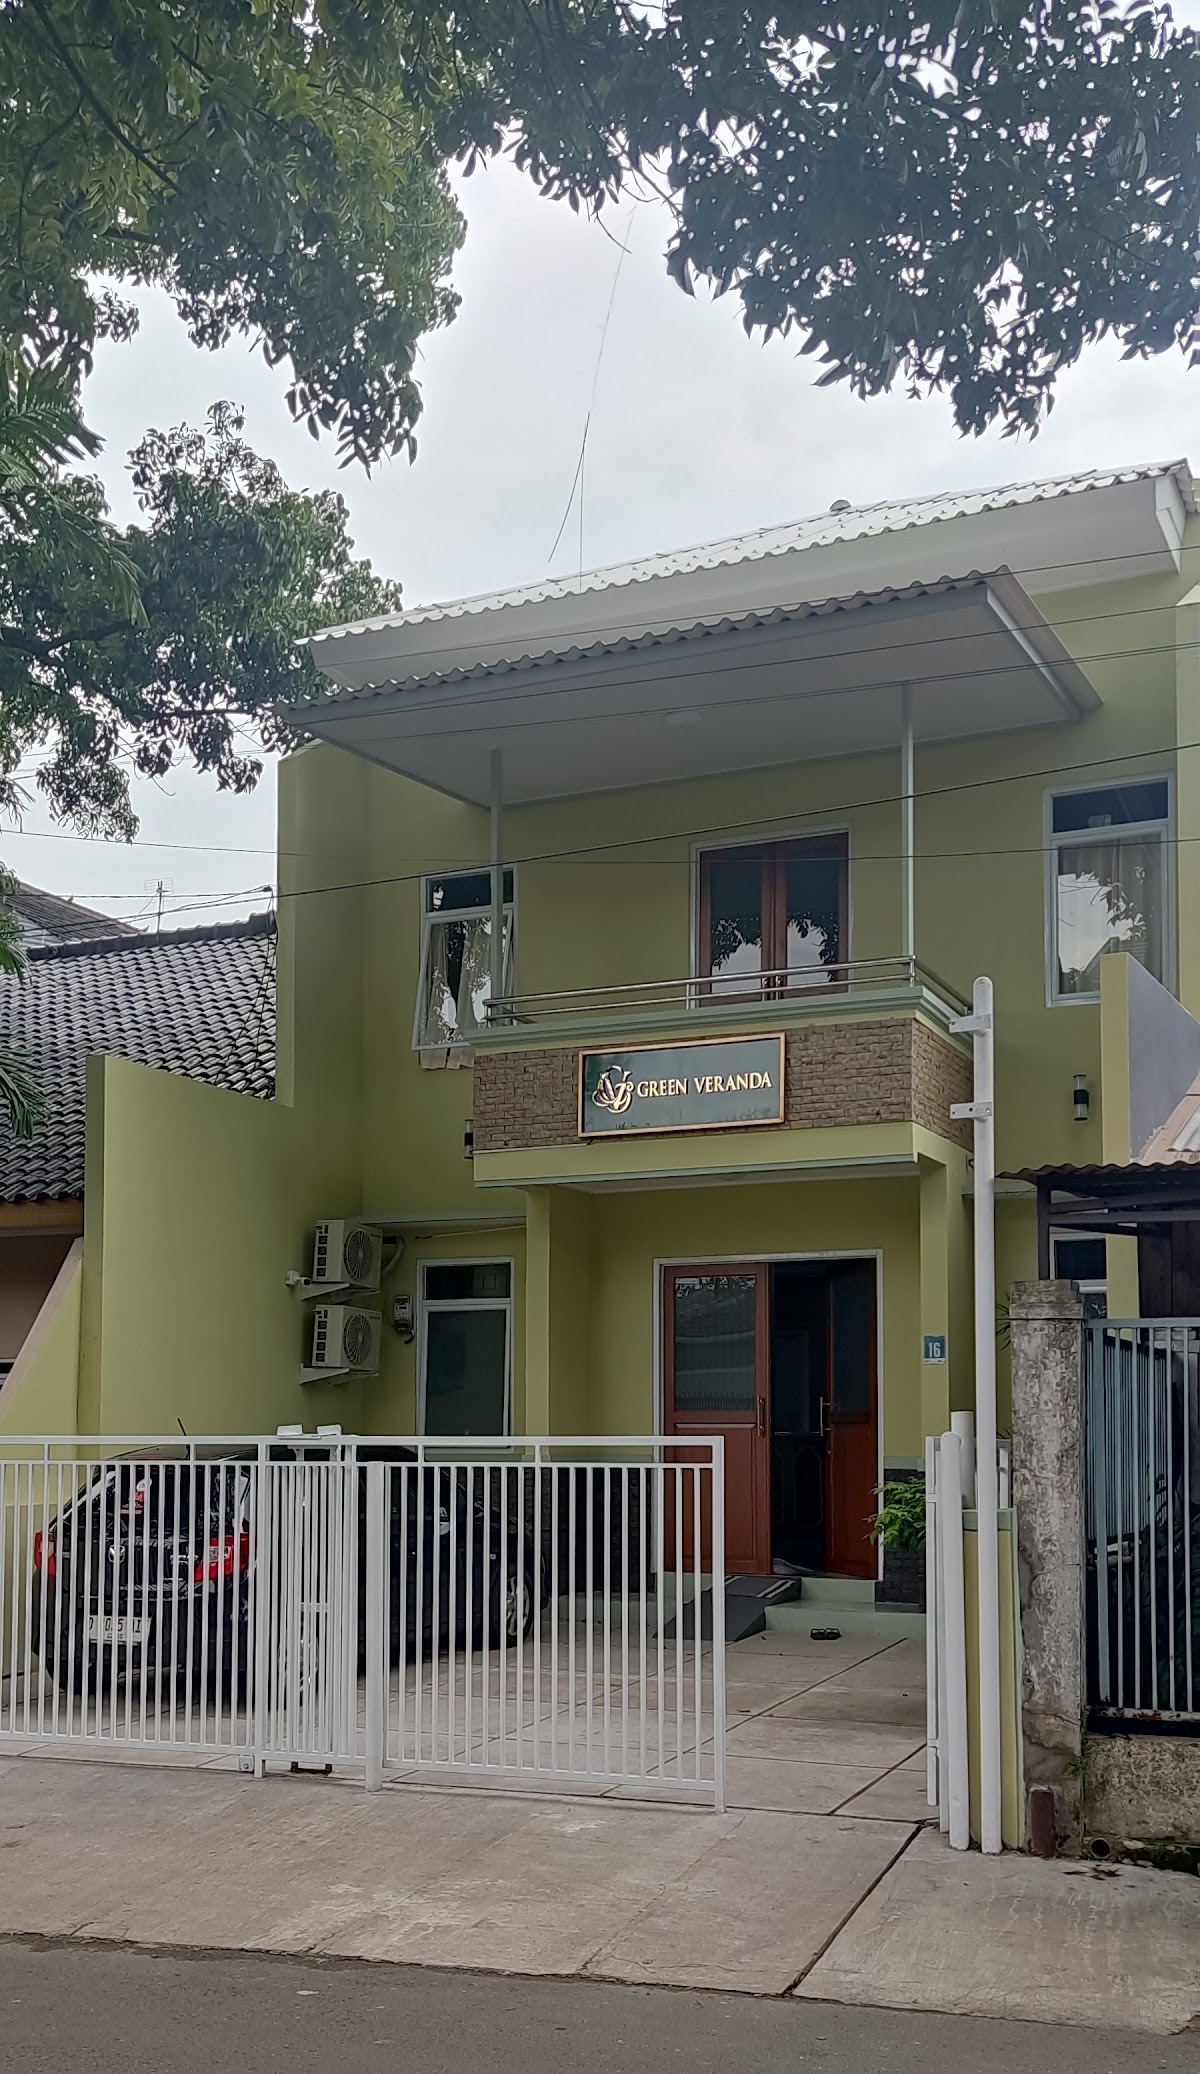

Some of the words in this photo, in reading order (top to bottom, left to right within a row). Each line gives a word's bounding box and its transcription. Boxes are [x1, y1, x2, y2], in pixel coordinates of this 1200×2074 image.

[636, 1077, 688, 1098] GREEN
[694, 1071, 773, 1094] VERANDA
[928, 1341, 941, 1358] 16
